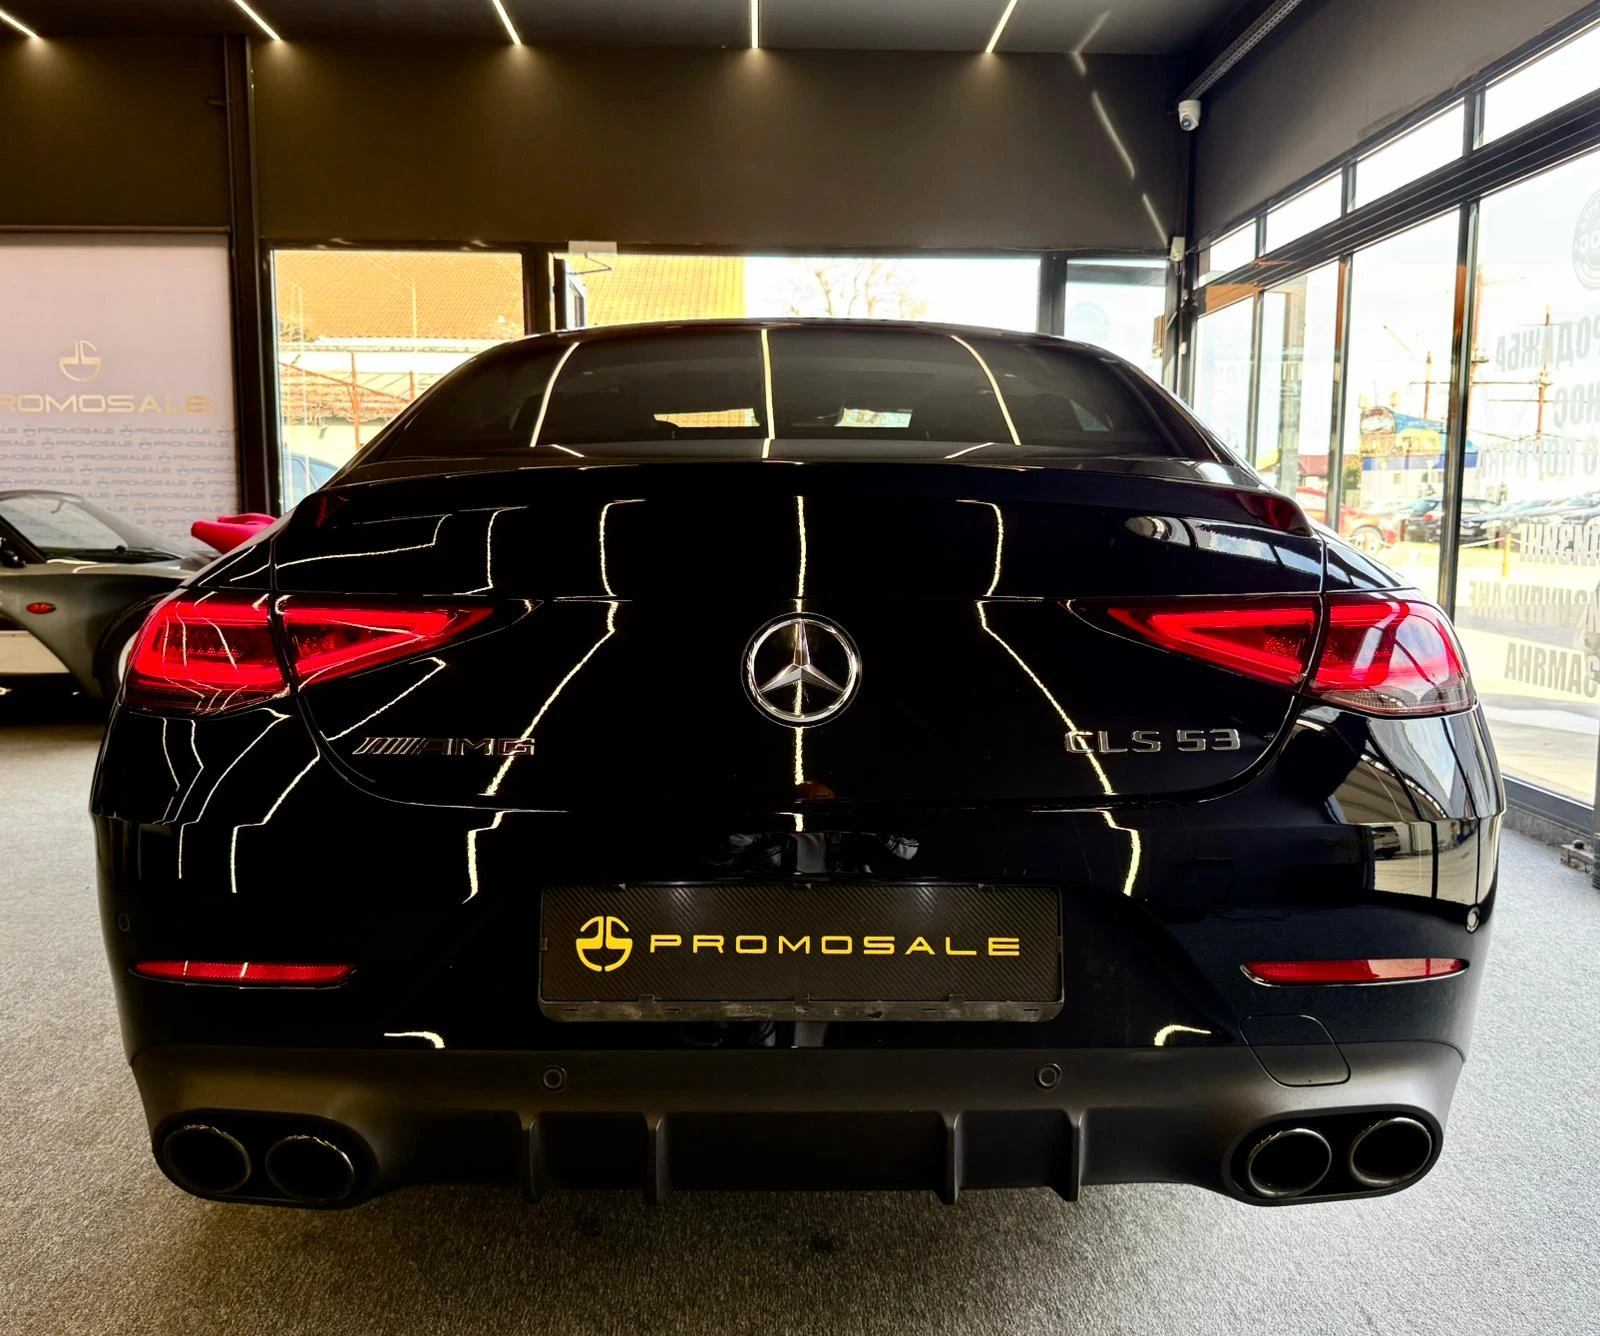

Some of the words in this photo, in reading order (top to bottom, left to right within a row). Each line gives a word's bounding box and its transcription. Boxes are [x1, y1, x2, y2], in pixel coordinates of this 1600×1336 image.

[1065, 730, 1161, 752] CLS
[1177, 729, 1240, 751] 53
[650, 935, 1020, 956] PROMOSALE
